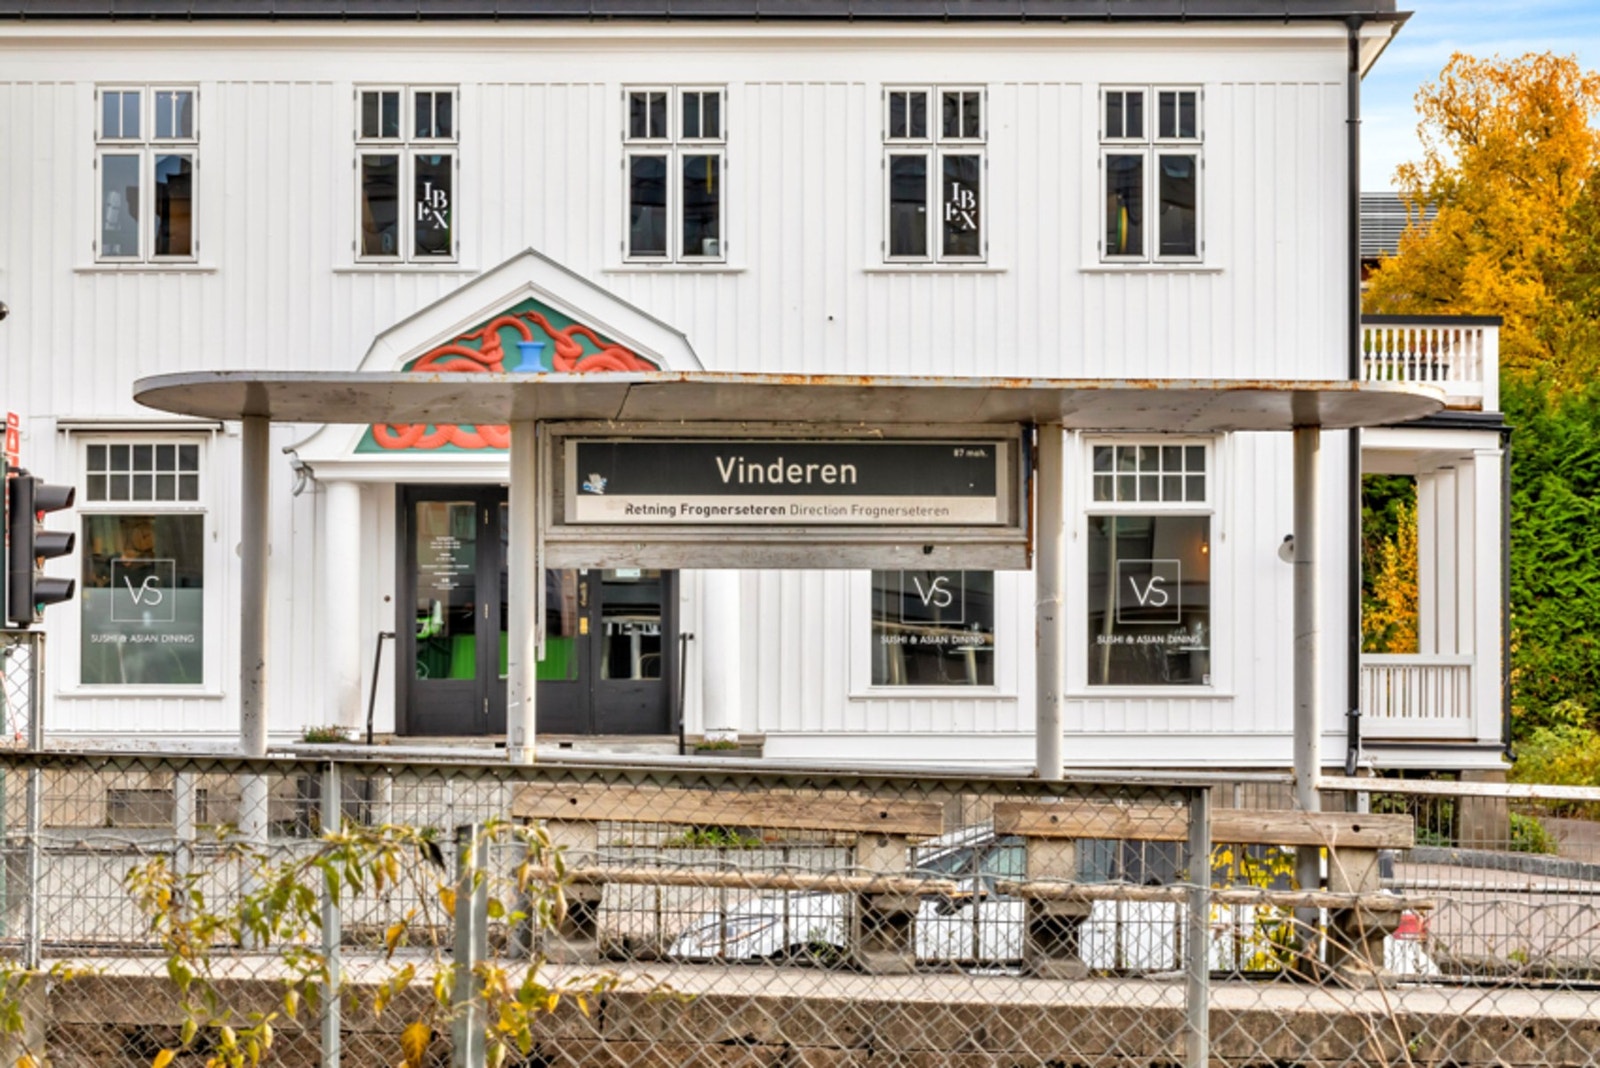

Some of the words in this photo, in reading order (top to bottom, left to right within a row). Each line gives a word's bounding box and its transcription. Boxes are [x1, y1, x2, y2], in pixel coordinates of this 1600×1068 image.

[715, 456, 857, 484] Vinderen
[625, 503, 676, 518] Retning
[681, 503, 786, 518] Frognerseteren
[790, 504, 848, 516] Direction
[851, 504, 949, 518] Frognerseteren
[123, 575, 163, 605] VS
[913, 576, 952, 607] VS
[1129, 576, 1168, 607] VS
[91, 634, 119, 643] SUSHI
[130, 634, 159, 643] ASIAN
[161, 634, 195, 643] DINING
[881, 635, 907, 645] SUSHI
[920, 635, 948, 645] ASIAN
[952, 635, 985, 645] DINING
[1097, 634, 1124, 644] SUSHI
[1137, 634, 1164, 644] ASIAN
[1167, 634, 1201, 644] DINING
